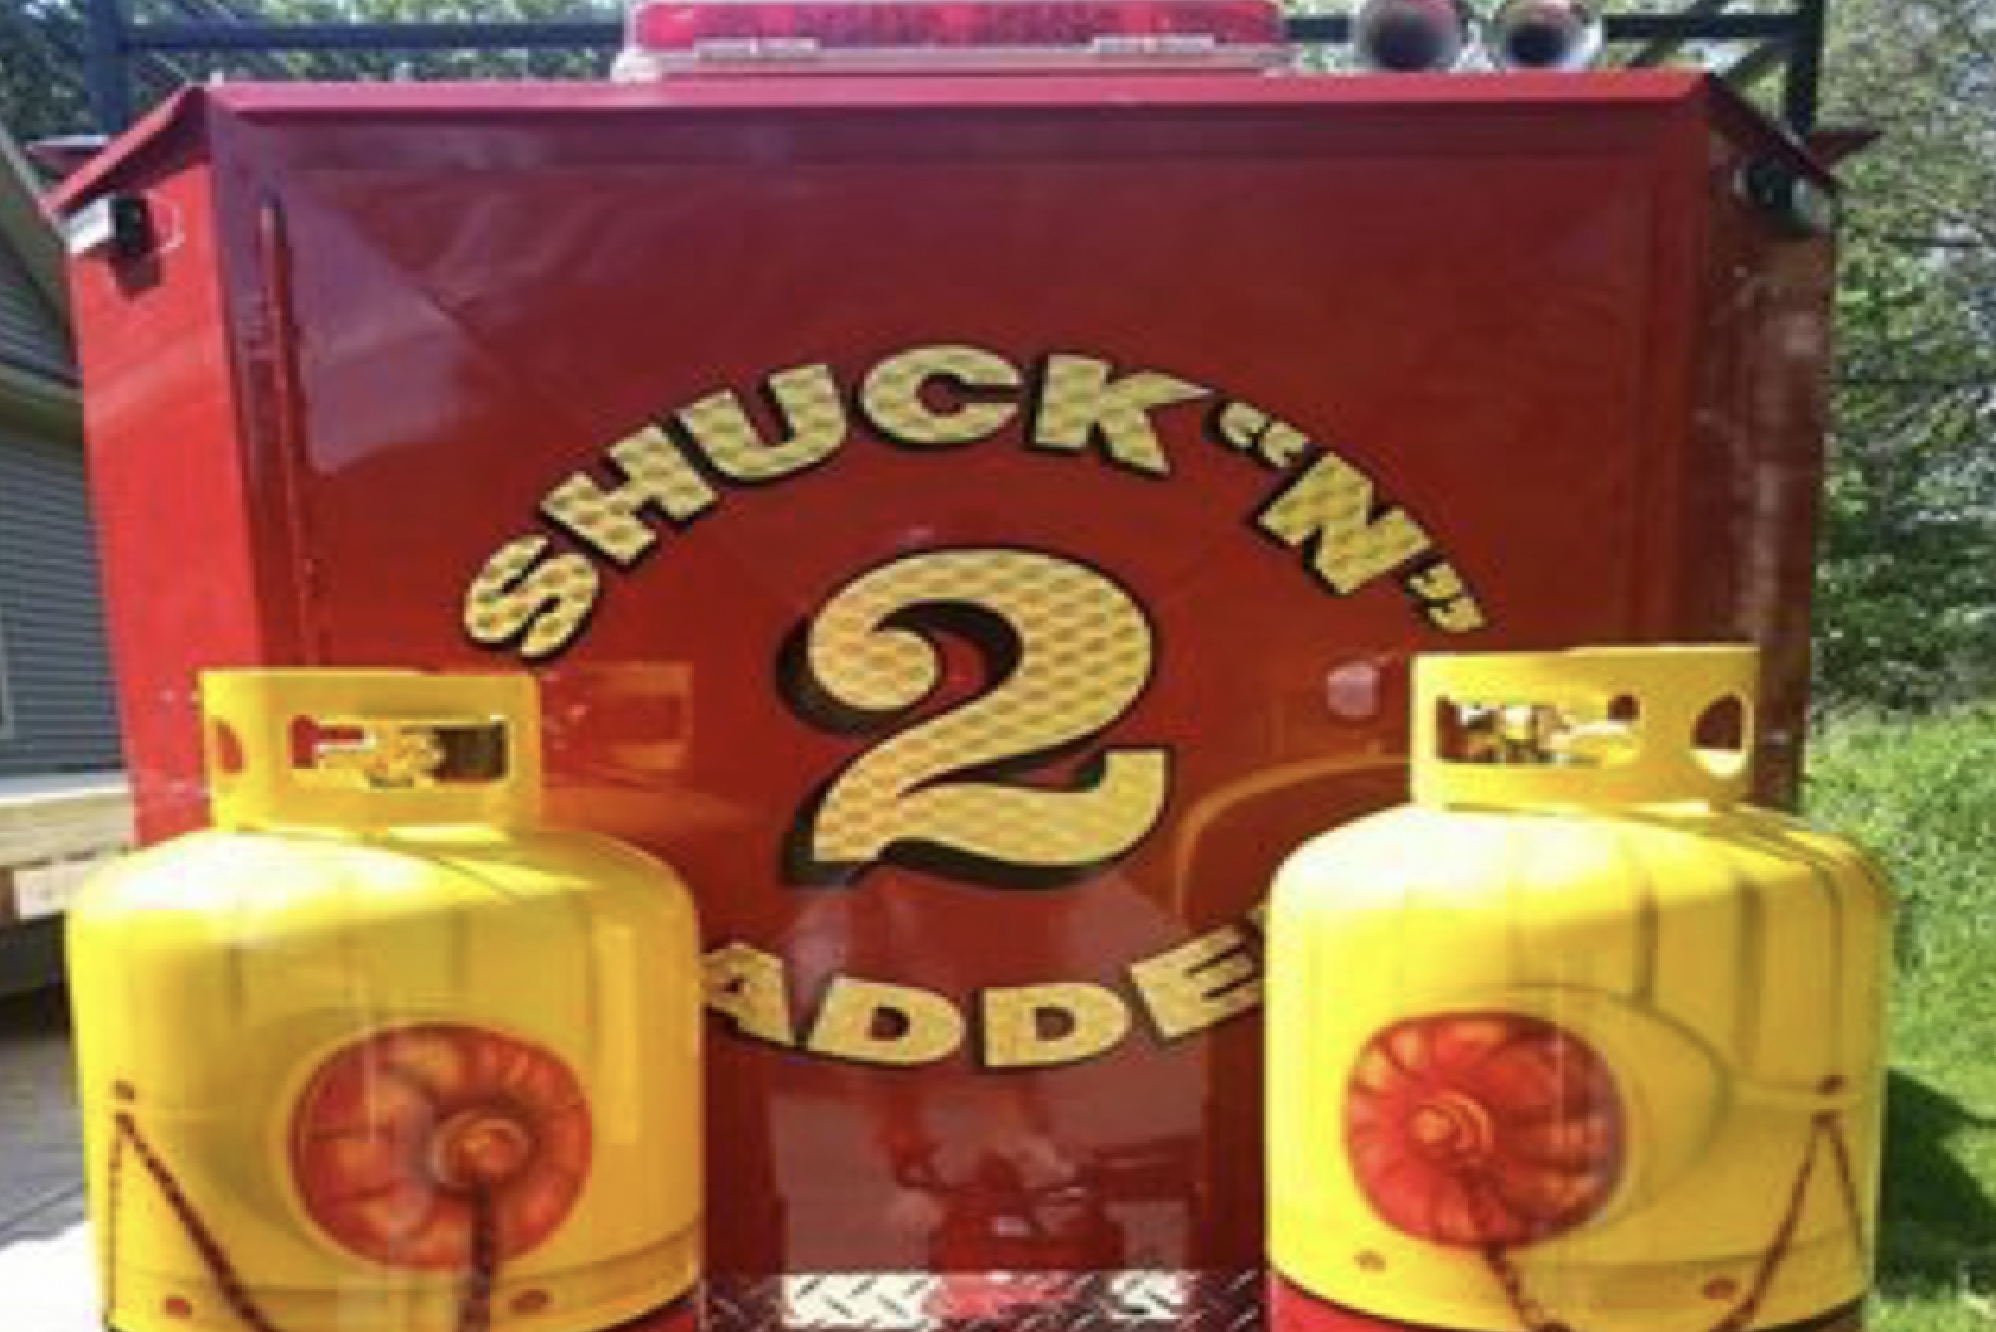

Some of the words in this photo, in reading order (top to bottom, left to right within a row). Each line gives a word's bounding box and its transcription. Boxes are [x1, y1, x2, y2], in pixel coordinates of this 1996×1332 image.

[463, 343, 1213, 658] SHUCK
[798, 547, 1170, 872] 2
[700, 900, 1264, 1067] ADDE
